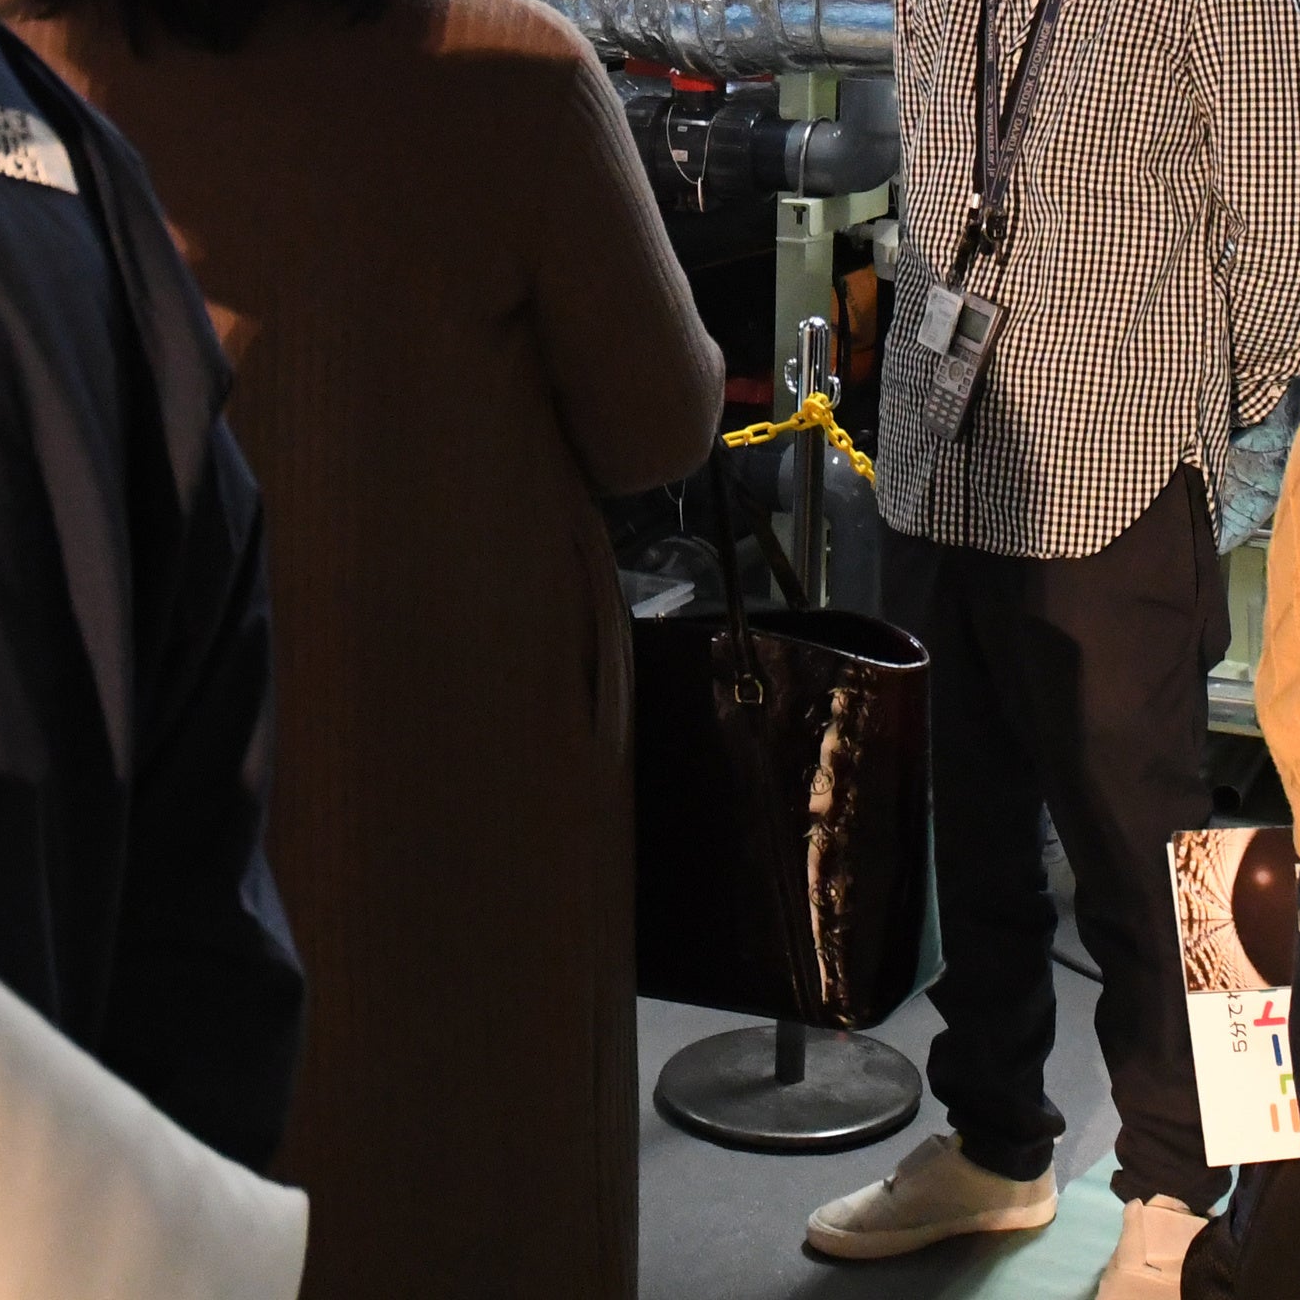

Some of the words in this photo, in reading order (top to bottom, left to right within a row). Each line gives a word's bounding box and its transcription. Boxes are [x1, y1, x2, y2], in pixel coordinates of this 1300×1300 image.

[1006, 117, 1024, 152] TOKYO
[1016, 79, 1035, 115] STOCK
[1028, 21, 1052, 77] EXCHANGE
